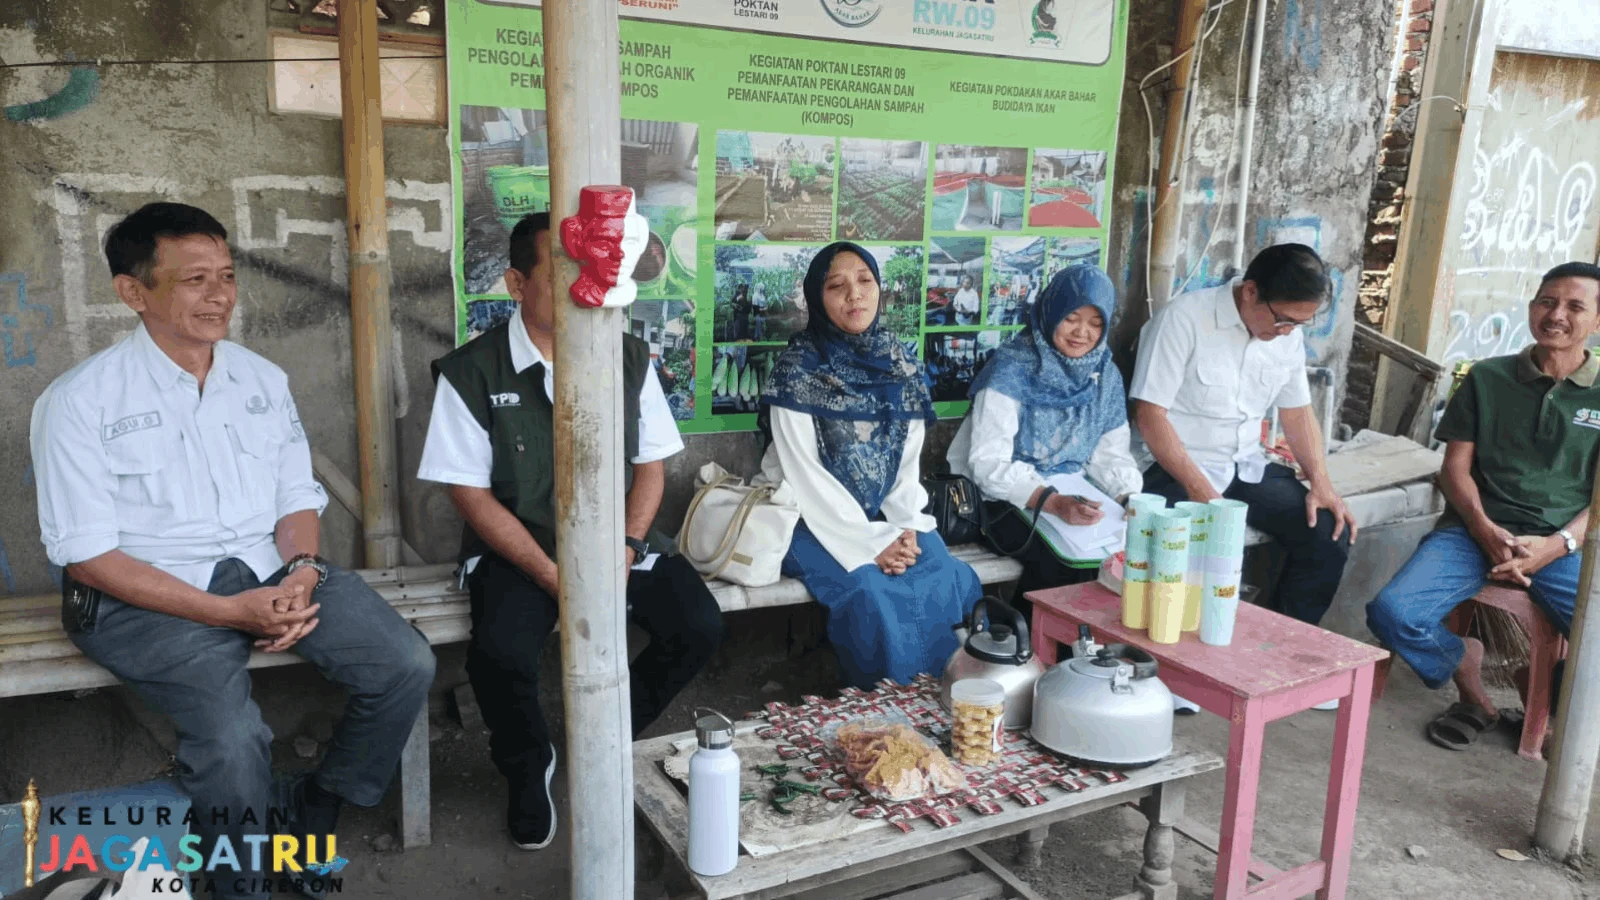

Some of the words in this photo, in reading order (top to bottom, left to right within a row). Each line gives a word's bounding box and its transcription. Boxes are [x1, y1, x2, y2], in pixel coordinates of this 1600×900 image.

[734, 0, 778, 11] POKTAN
[734, 8, 768, 19] LESTARI
[769, 12, 779, 20] 09
[913, 0, 996, 31] RW.09
[496, 28, 544, 47] KEGIA
[912, 26, 954, 38] KELURAHAN
[635, 62, 695, 82] ORGANIK
[749, 53, 803, 71] KEGIATAN
[805, 59, 849, 75] POKTAN
[851, 64, 892, 79] LESTARI
[894, 68, 906, 80] 09
[738, 71, 817, 89] PEMANFAATAN
[820, 78, 891, 95] PEKARANGAN
[894, 84, 914, 97] DAN
[950, 81, 993, 95] KEGIATAN
[995, 85, 1042, 98] POKDAKAN
[1044, 89, 1067, 100] AKAR
[1068, 91, 1096, 103] BAHAR
[727, 87, 808, 106] PEMANFAATAN
[810, 94, 881, 111] PENGOLAHAN
[884, 100, 924, 114] SAMPAH
[992, 99, 1034, 113] BUDIDAYA
[1035, 103, 1056, 113] IKAN
[801, 111, 854, 128] (KOMPOS)
